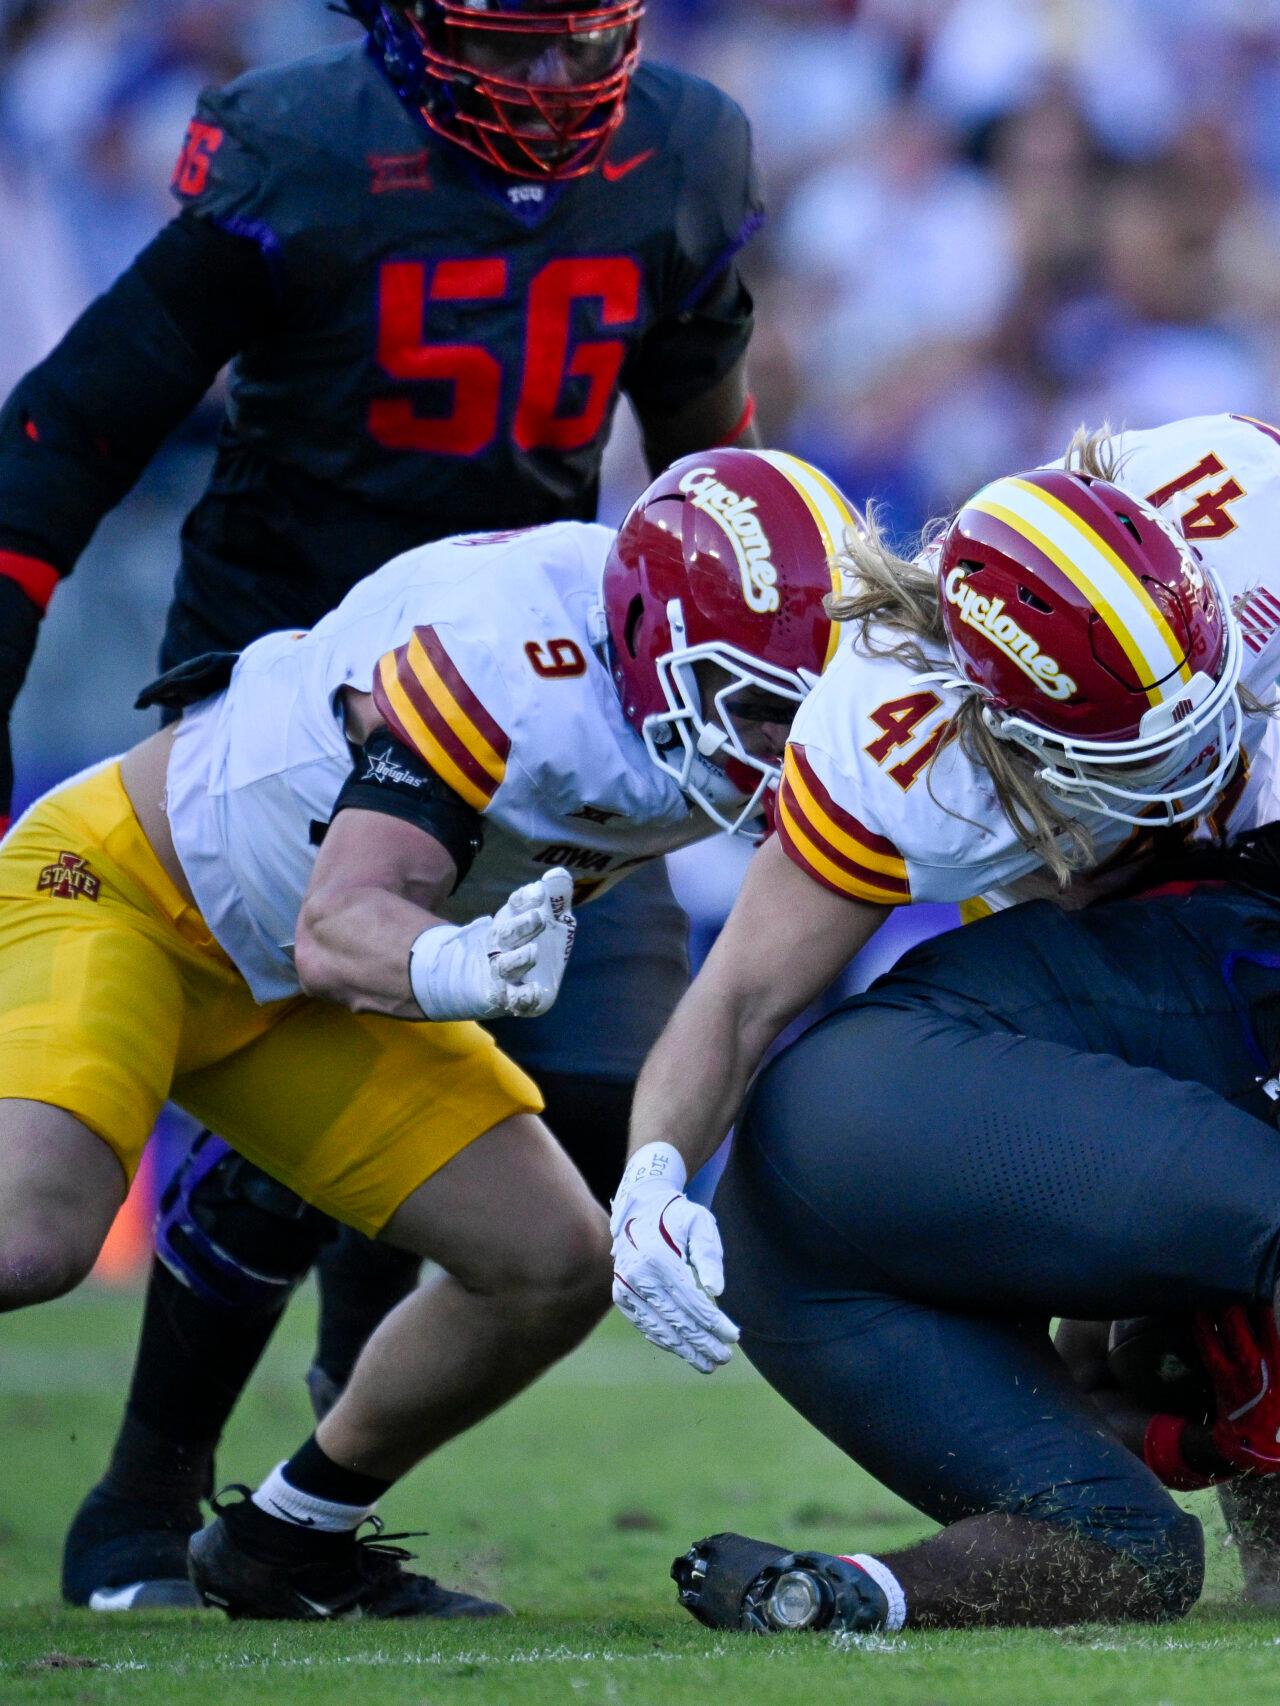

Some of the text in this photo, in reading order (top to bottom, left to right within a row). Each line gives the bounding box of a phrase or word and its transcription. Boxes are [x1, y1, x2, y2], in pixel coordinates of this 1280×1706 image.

[171, 119, 223, 195] 56
[367, 256, 641, 456] 56
[678, 467, 780, 613] Cyclones
[1143, 451, 1247, 541] 41
[523, 638, 587, 680] 9
[945, 567, 1077, 700] Cyclones
[374, 761, 422, 787] Douglas
[863, 690, 960, 793] 41
[40, 866, 97, 896] STATE
